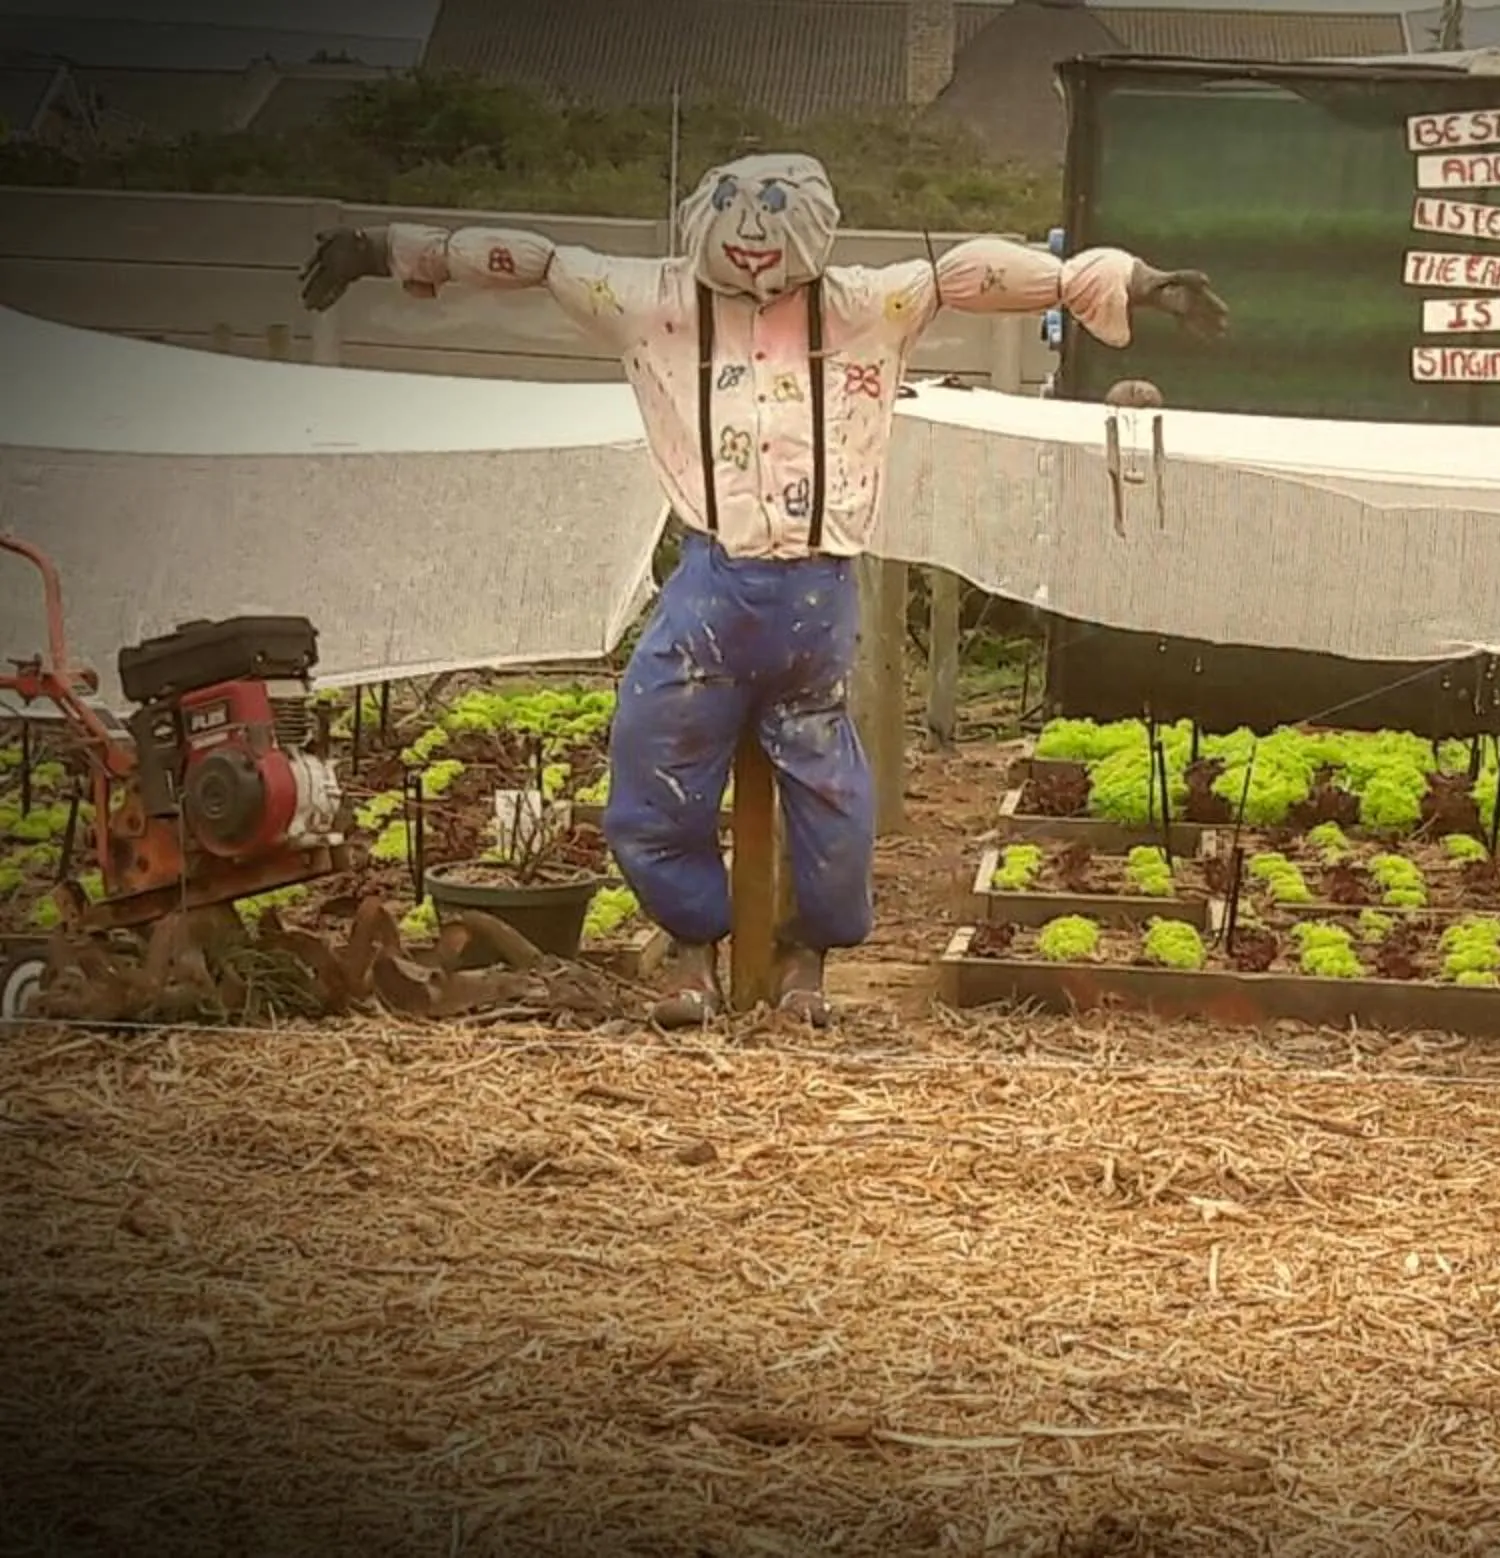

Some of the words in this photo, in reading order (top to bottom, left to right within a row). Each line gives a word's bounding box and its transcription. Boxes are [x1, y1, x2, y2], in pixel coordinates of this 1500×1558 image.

[1414, 114, 1461, 147] BE
[1411, 254, 1459, 284] THE
[1447, 300, 1492, 330] IS
